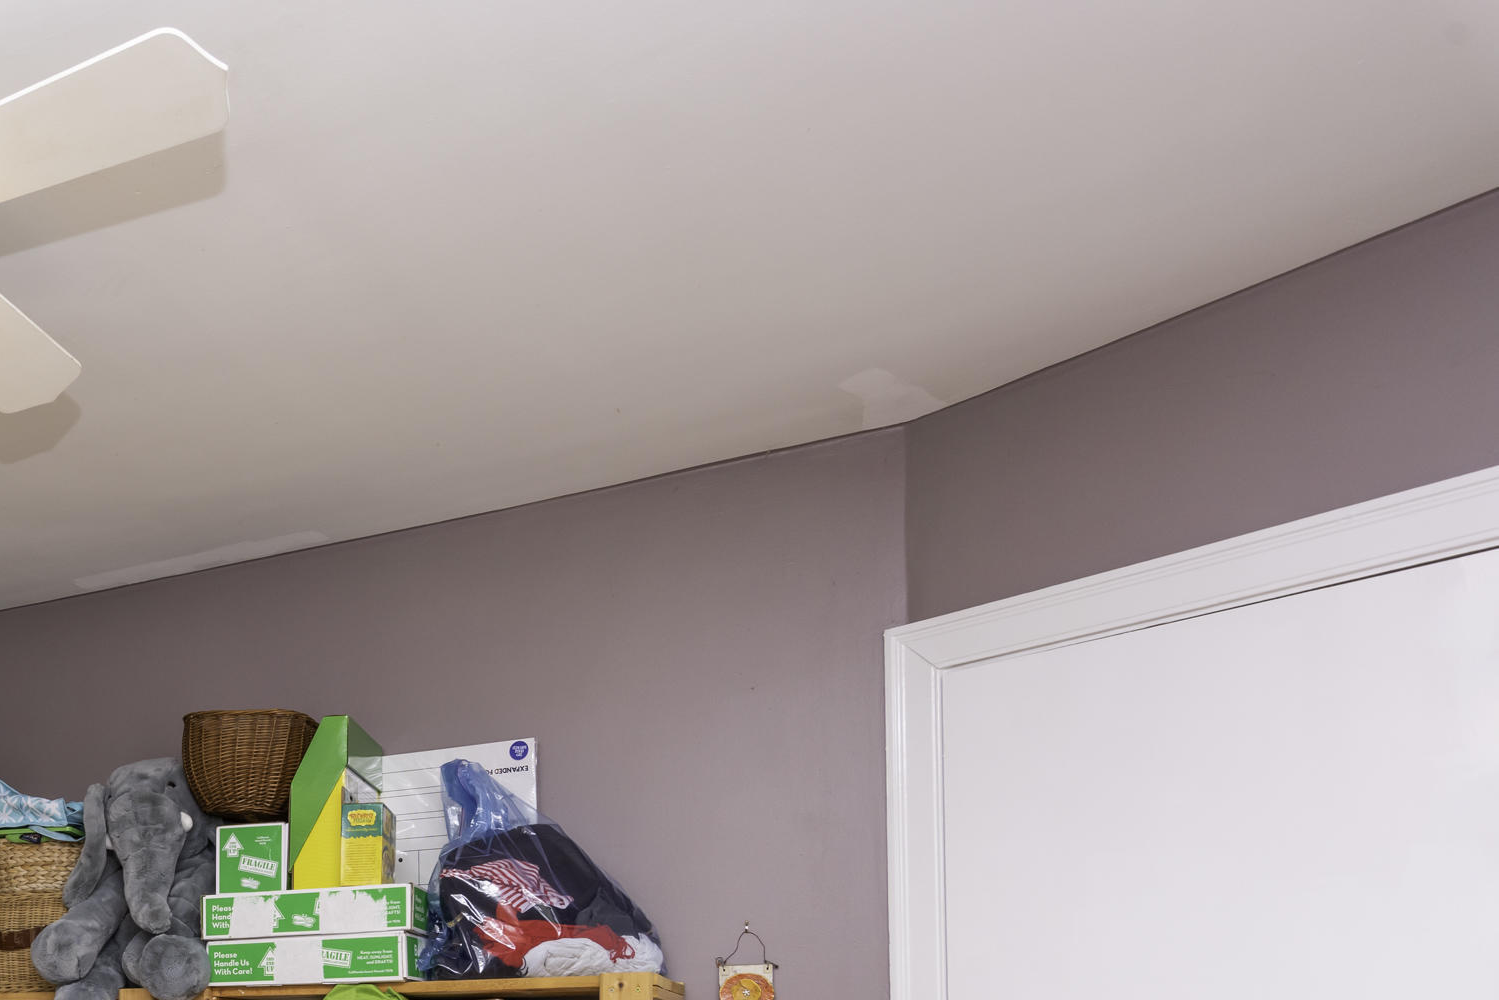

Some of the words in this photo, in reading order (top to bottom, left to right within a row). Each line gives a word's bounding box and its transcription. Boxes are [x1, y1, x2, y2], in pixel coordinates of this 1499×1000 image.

[494, 765, 528, 775] EXPANDED
[242, 857, 276, 871] FRAGILE
[213, 951, 238, 960] Please
[213, 959, 239, 968] Handle
[240, 959, 250, 967] Us
[214, 967, 232, 976] With
[232, 967, 253, 976] Care!
